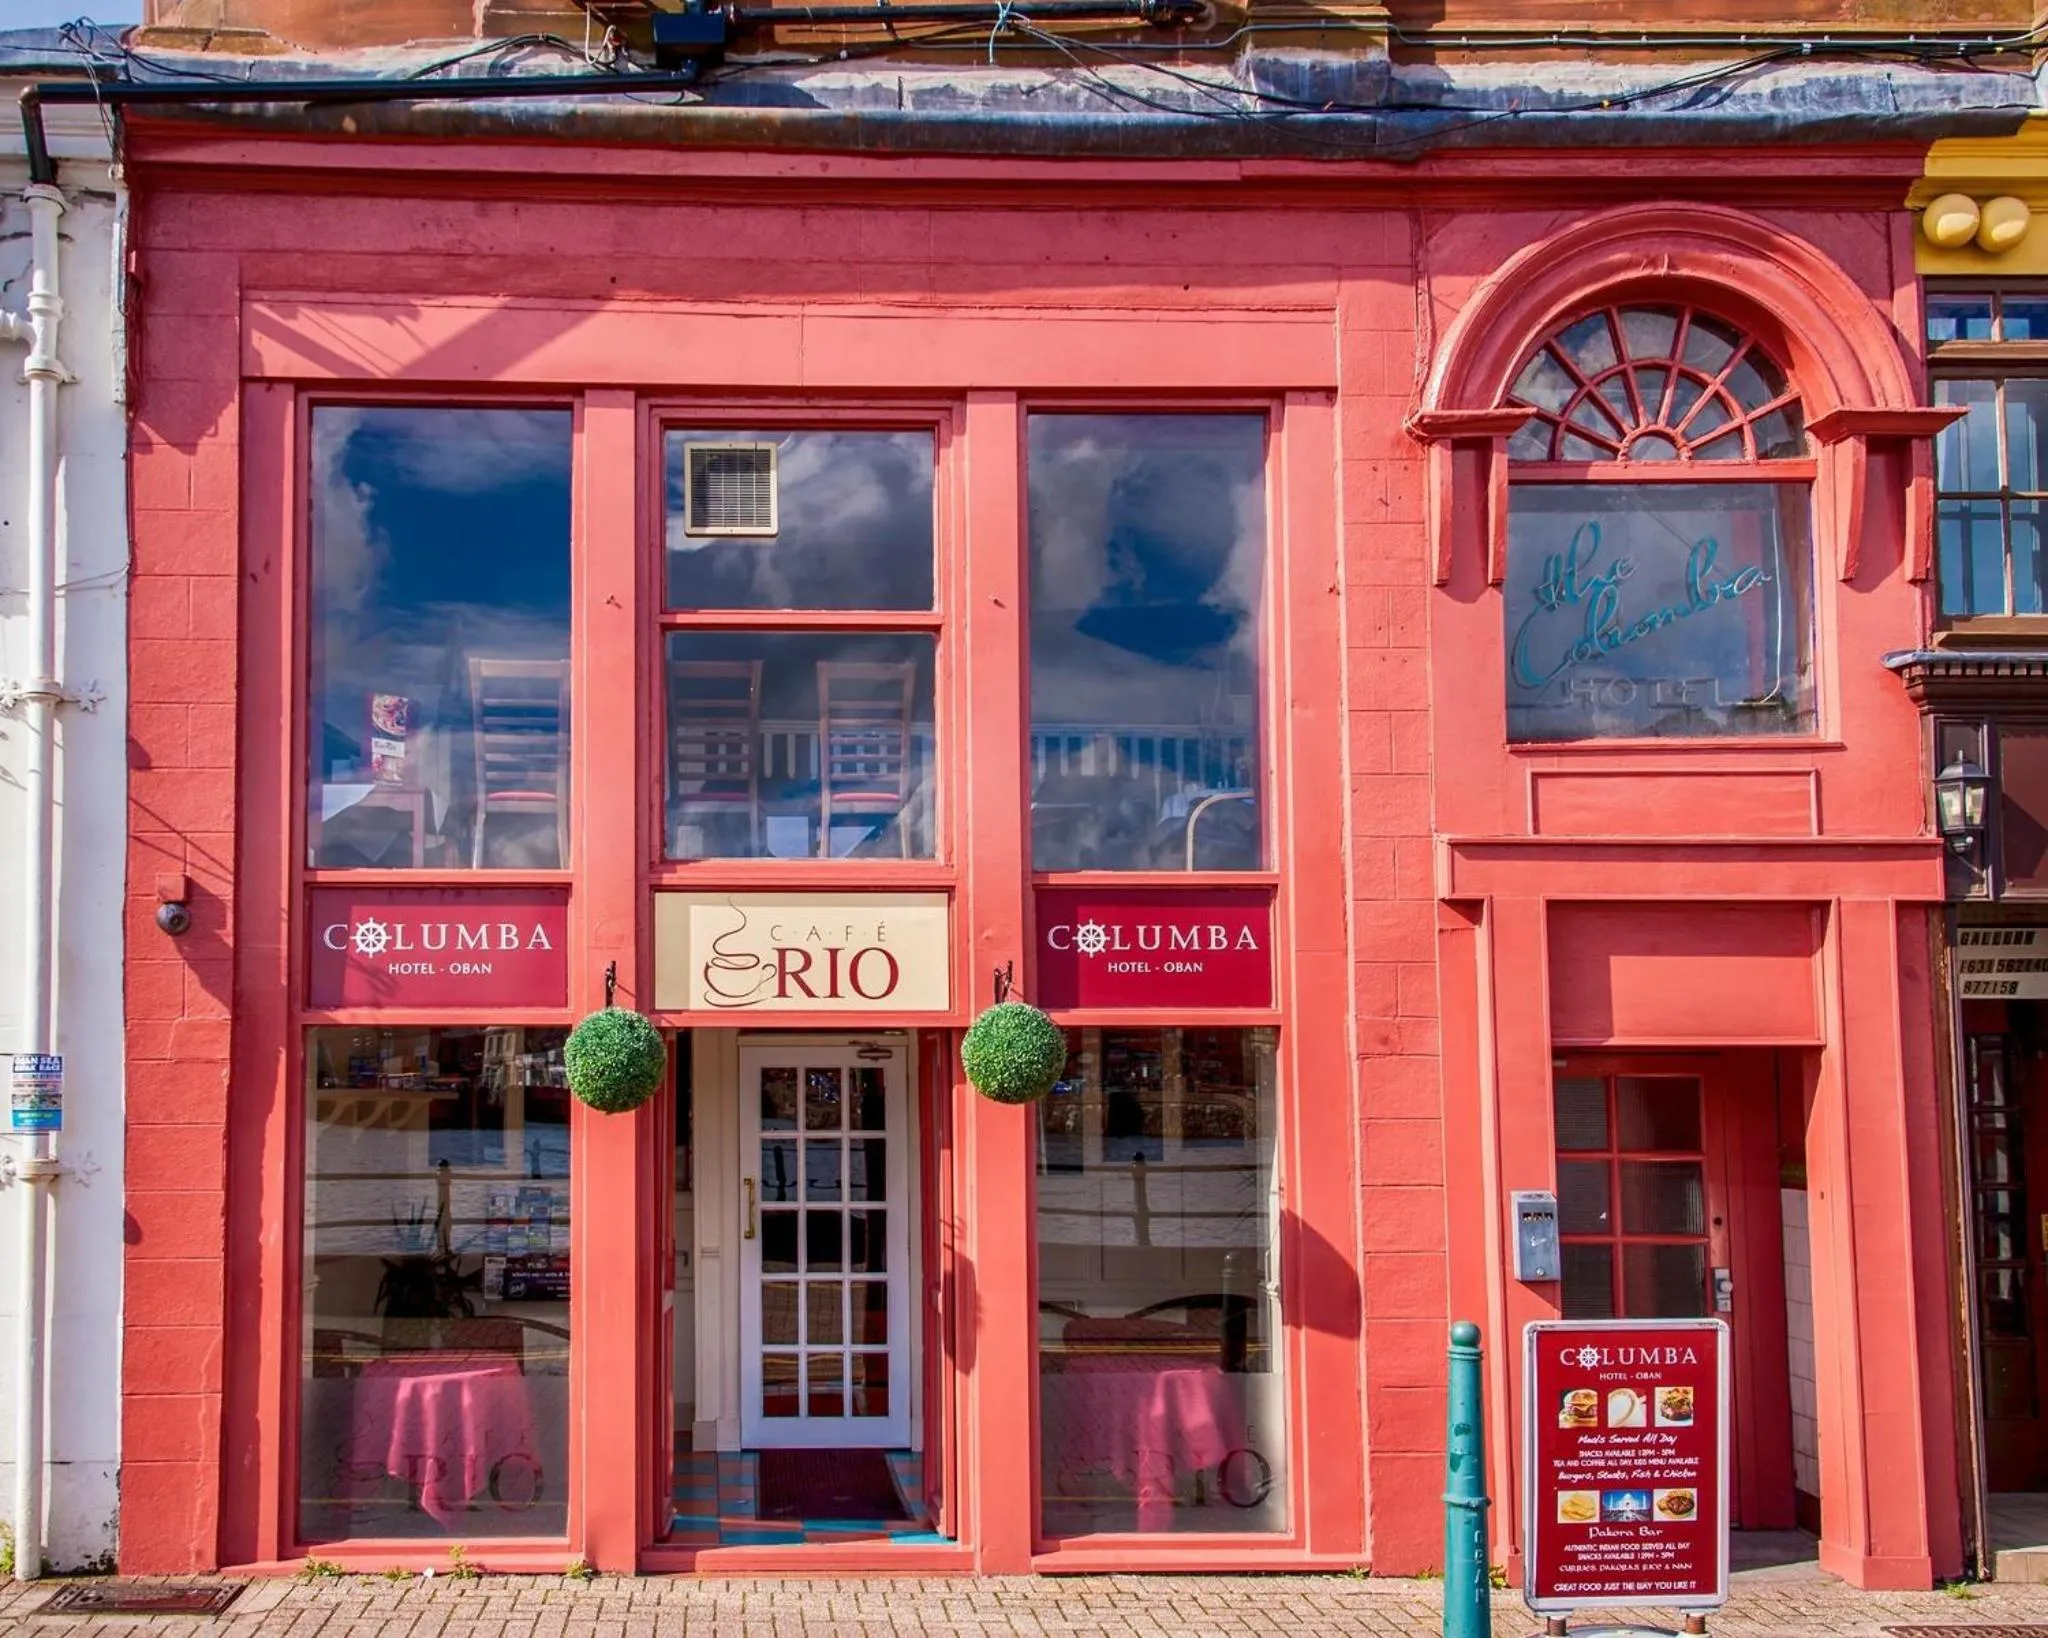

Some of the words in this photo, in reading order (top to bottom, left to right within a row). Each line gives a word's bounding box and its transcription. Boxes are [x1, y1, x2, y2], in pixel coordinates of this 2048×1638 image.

[388, 963, 435, 975] HOTEL
[449, 963, 492, 975] OBAN
[1107, 962, 1151, 973] HOTEL
[1164, 961, 1203, 973] OBAN
[771, 947, 899, 1000] RIO
[1600, 1372, 1628, 1380] HOTEL
[1635, 1372, 1662, 1380] OBAN
[1577, 1434, 1606, 1444] Meals
[1609, 1433, 1640, 1444] Served
[1642, 1432, 1658, 1445] All
[1658, 1432, 1678, 1446] Day
[1631, 1469, 1651, 1479] Fish
[1663, 1468, 1697, 1479] Chicken
[1589, 1526, 1634, 1539] Pakora
[1639, 1525, 1664, 1537] Bar
[1620, 1543, 1640, 1551] FOOD
[1553, 1582, 1578, 1591] GREAT
[1578, 1582, 1602, 1591] FOOD
[1603, 1582, 1620, 1591] JUST
[1653, 1581, 1673, 1590] YOU
[1673, 1580, 1689, 1590] LIKE
